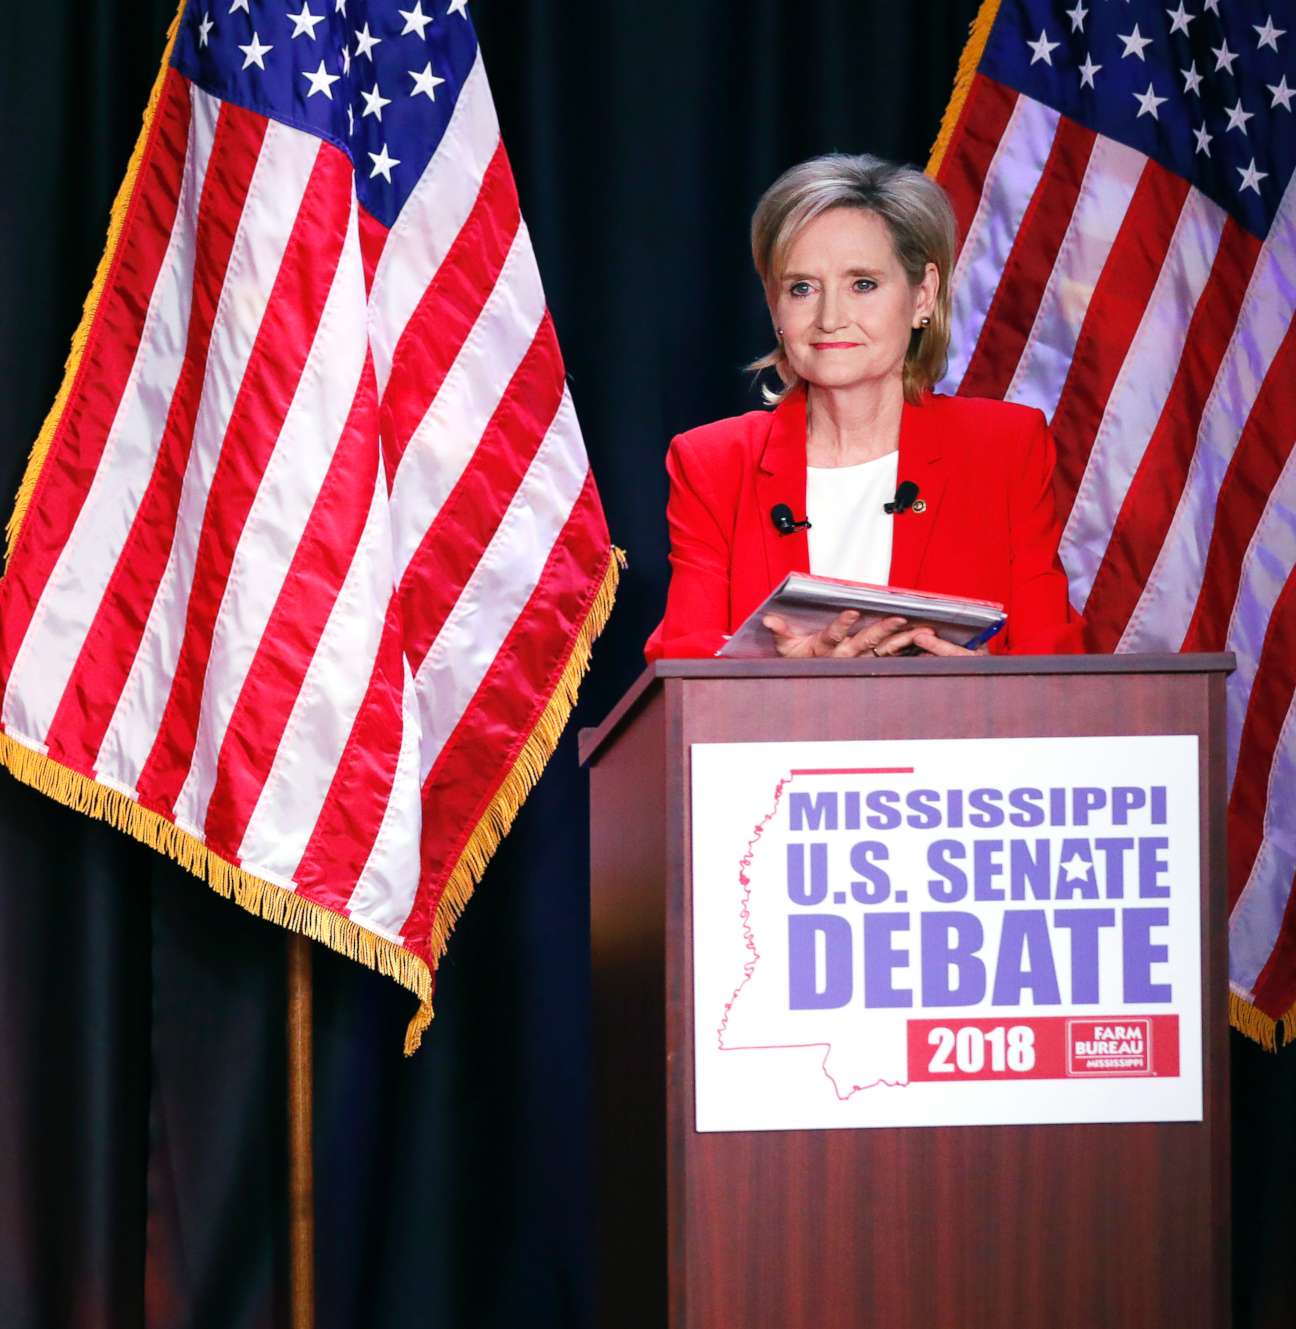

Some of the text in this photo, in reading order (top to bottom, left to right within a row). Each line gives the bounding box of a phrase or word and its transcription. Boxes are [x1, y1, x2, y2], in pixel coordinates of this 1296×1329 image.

[788, 785, 1168, 831] MISSISSIPPI
[786, 836, 1172, 906] U.S. SENATE
[787, 907, 1173, 1011] DEBATE
[927, 1025, 1036, 1074] 2018
[1074, 1040, 1144, 1055] BUREAU
[1094, 1025, 1143, 1041] FARM
[1086, 1058, 1144, 1069] MISSISSIPPI
